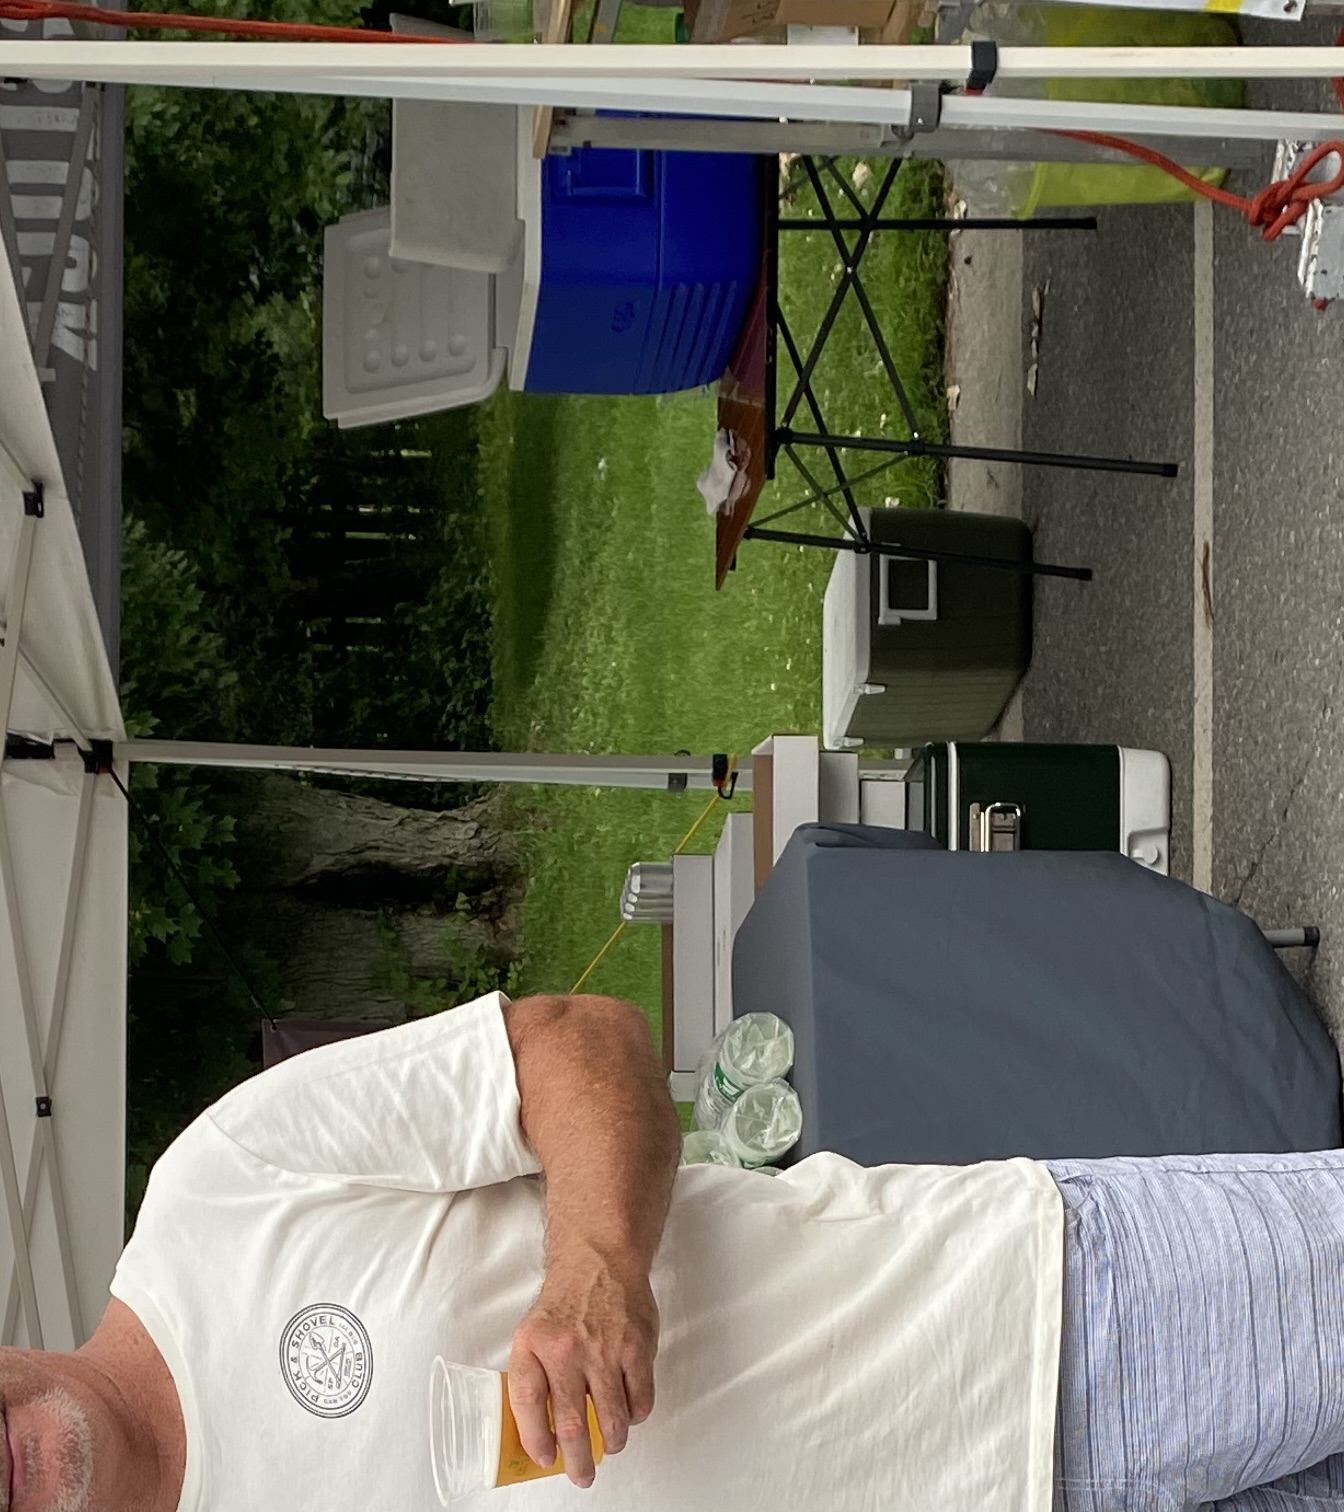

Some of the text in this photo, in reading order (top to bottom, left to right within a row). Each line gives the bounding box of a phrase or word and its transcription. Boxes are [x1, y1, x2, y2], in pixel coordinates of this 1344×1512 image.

[291, 1315, 334, 1402] PICK & SHOVEL
[352, 1352, 363, 1388] CLUB
